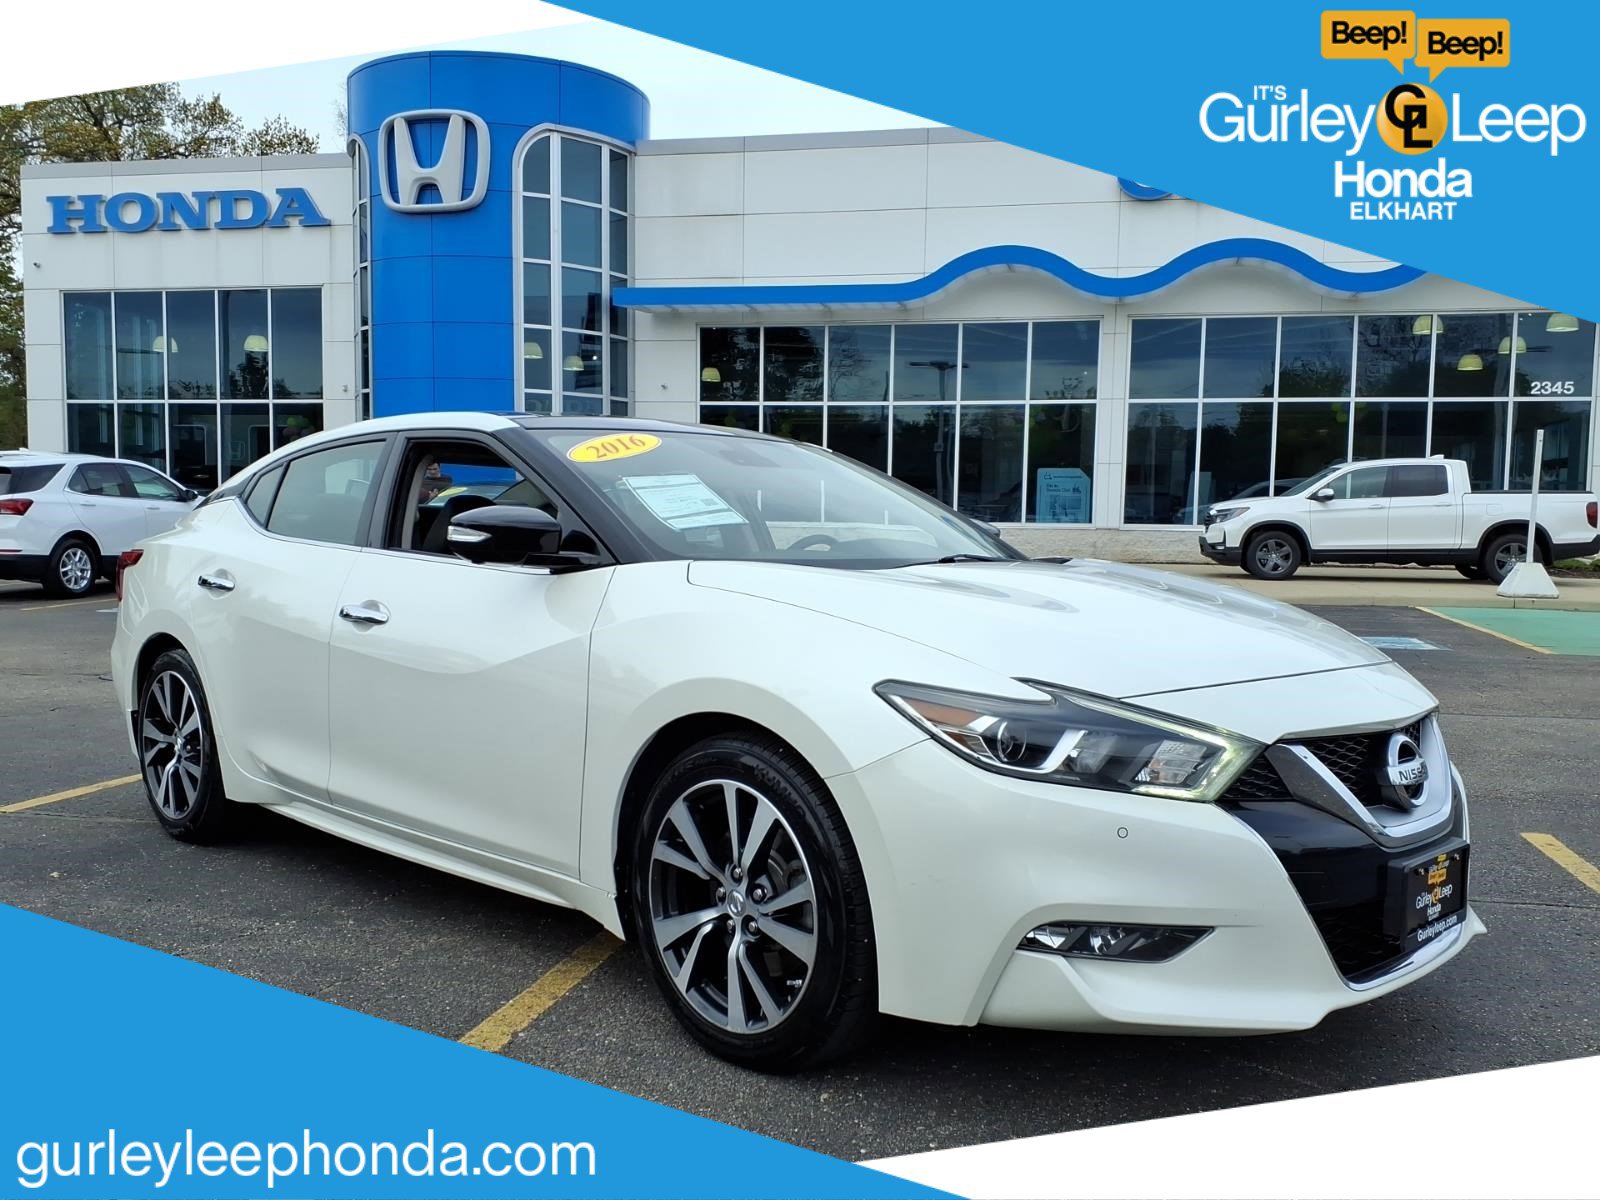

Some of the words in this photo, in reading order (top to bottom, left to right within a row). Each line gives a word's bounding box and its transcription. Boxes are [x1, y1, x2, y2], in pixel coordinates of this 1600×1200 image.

[46, 187, 332, 235] HONDA
[1530, 381, 1575, 395] 2345
[587, 435, 646, 459] 2016
